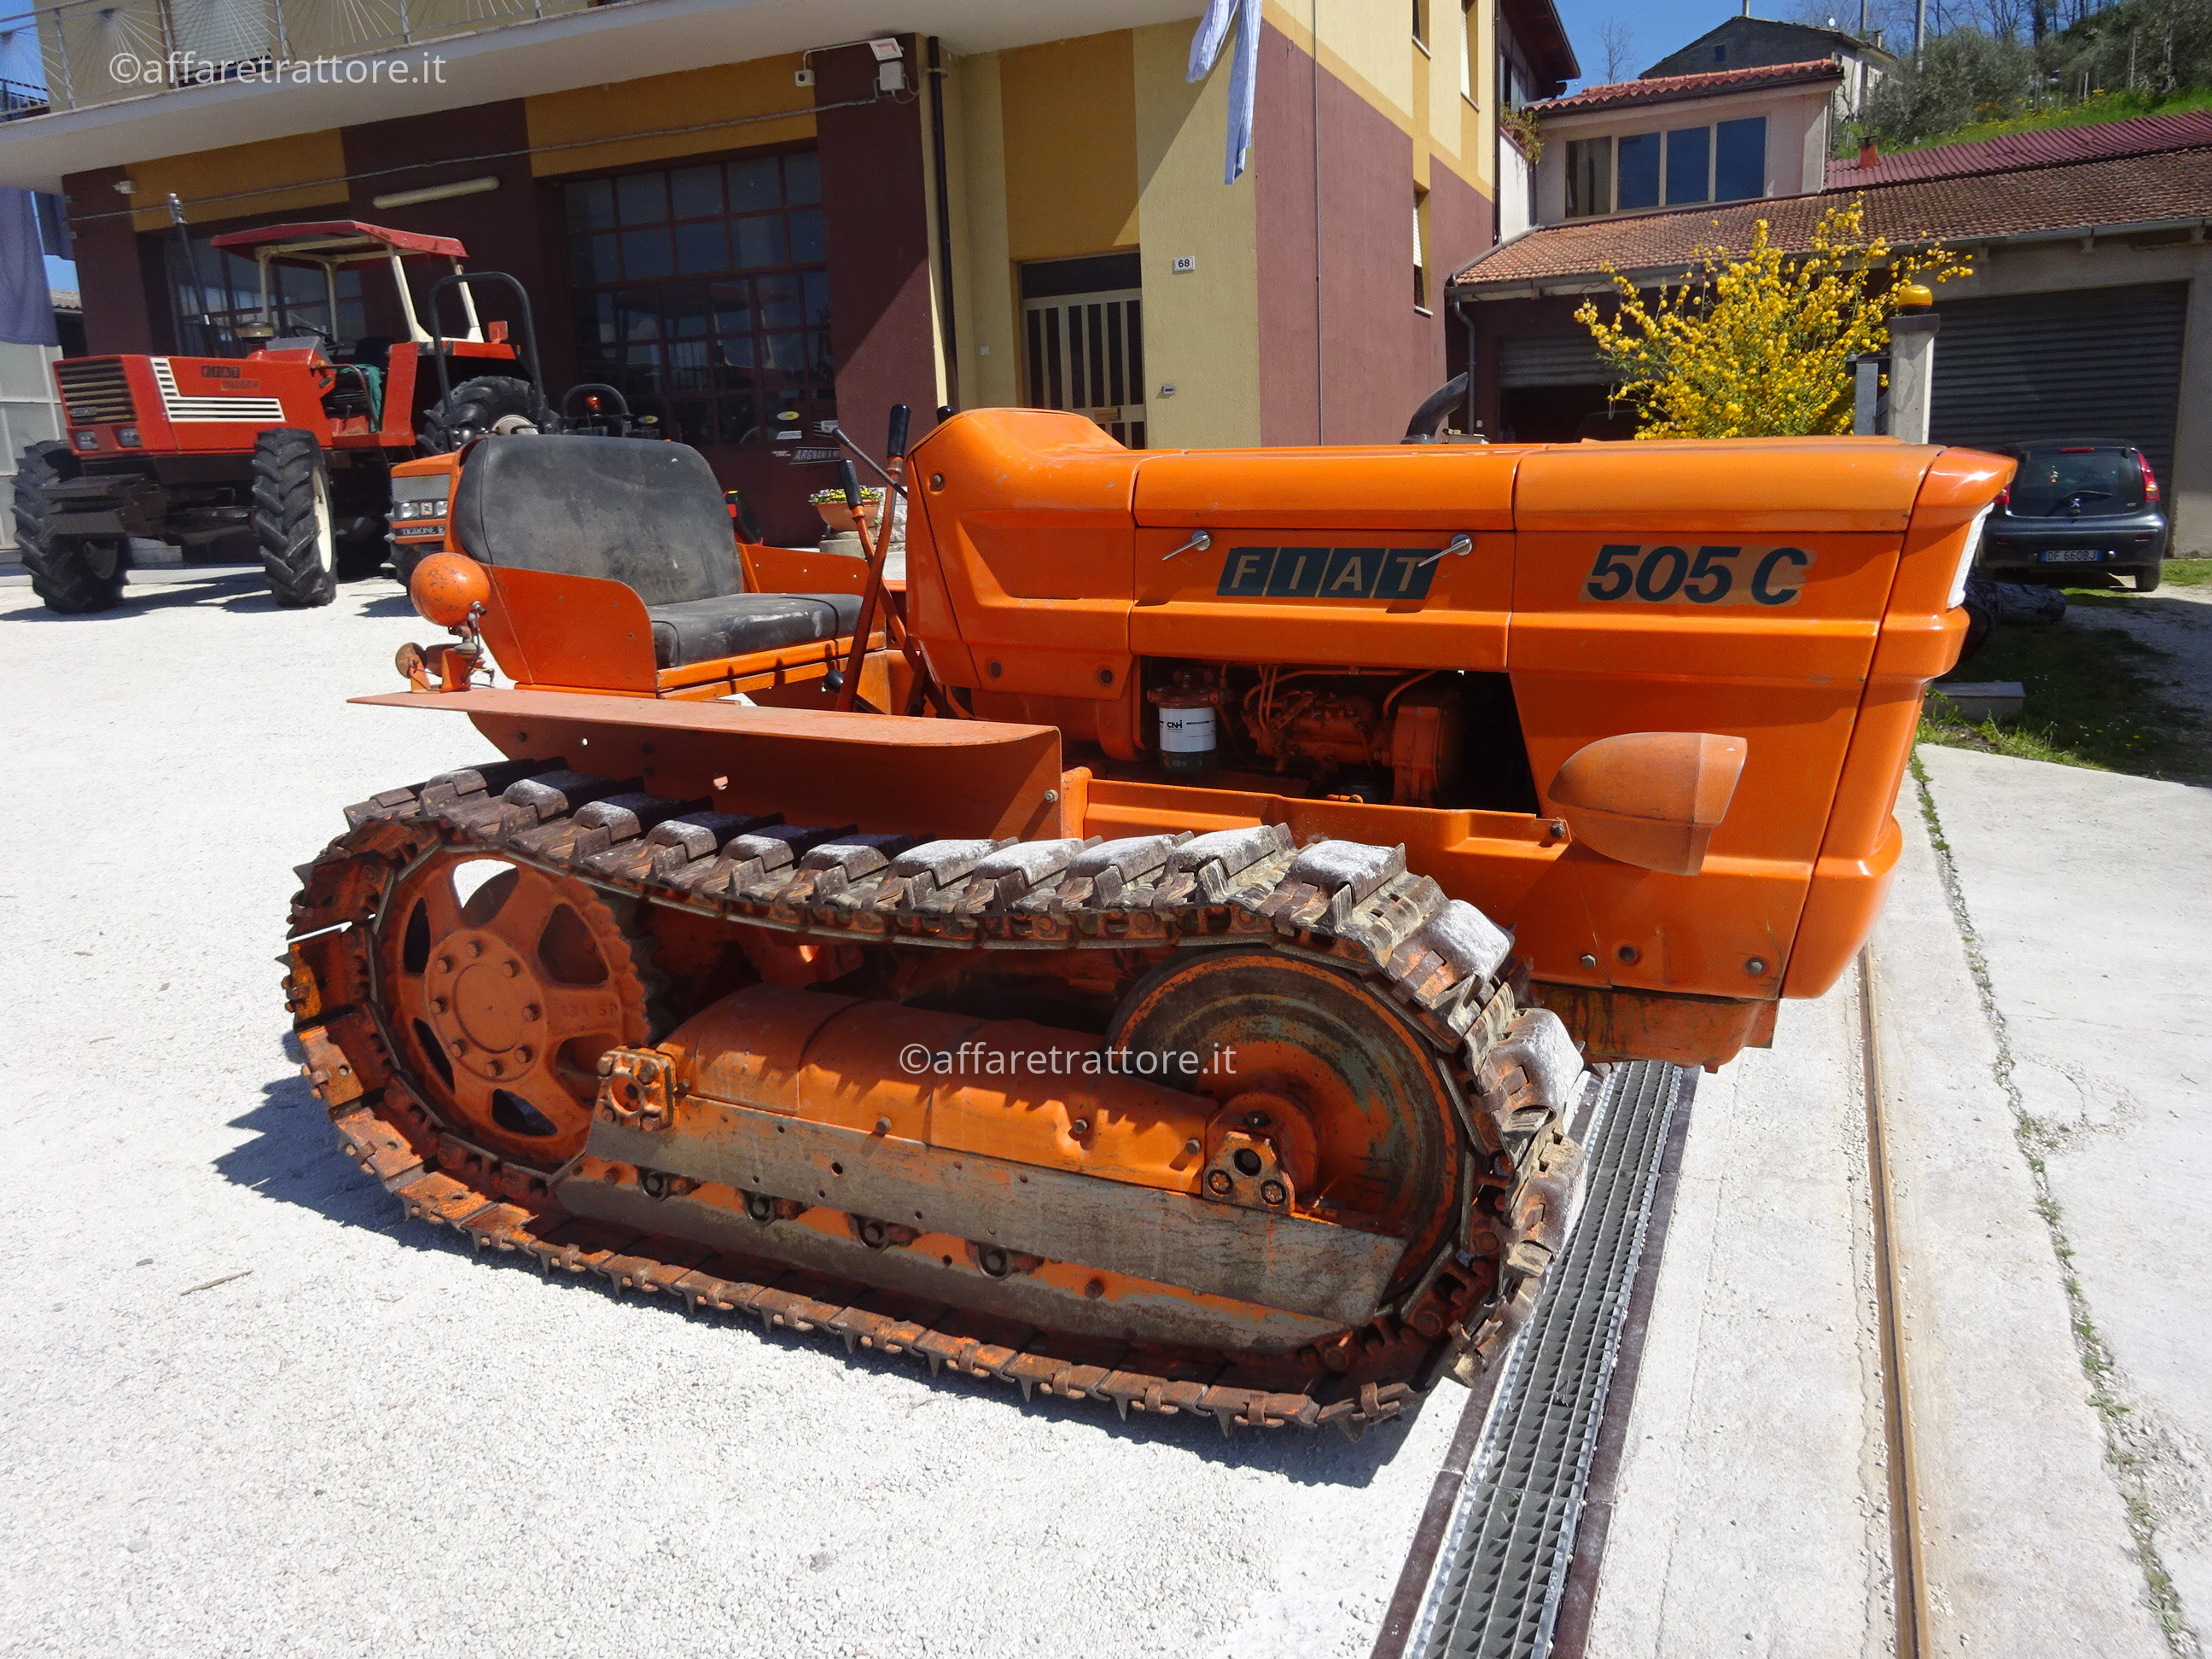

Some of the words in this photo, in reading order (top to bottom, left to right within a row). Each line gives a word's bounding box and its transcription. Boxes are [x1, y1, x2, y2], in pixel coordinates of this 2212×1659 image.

[1178, 259, 1190, 268] 68
[202, 366, 241, 378] FIAT
[2047, 551, 2062, 561] DF
[1230, 555, 1429, 592] FIAT
[1587, 544, 1742, 603] 505
[1751, 547, 1807, 606] C
